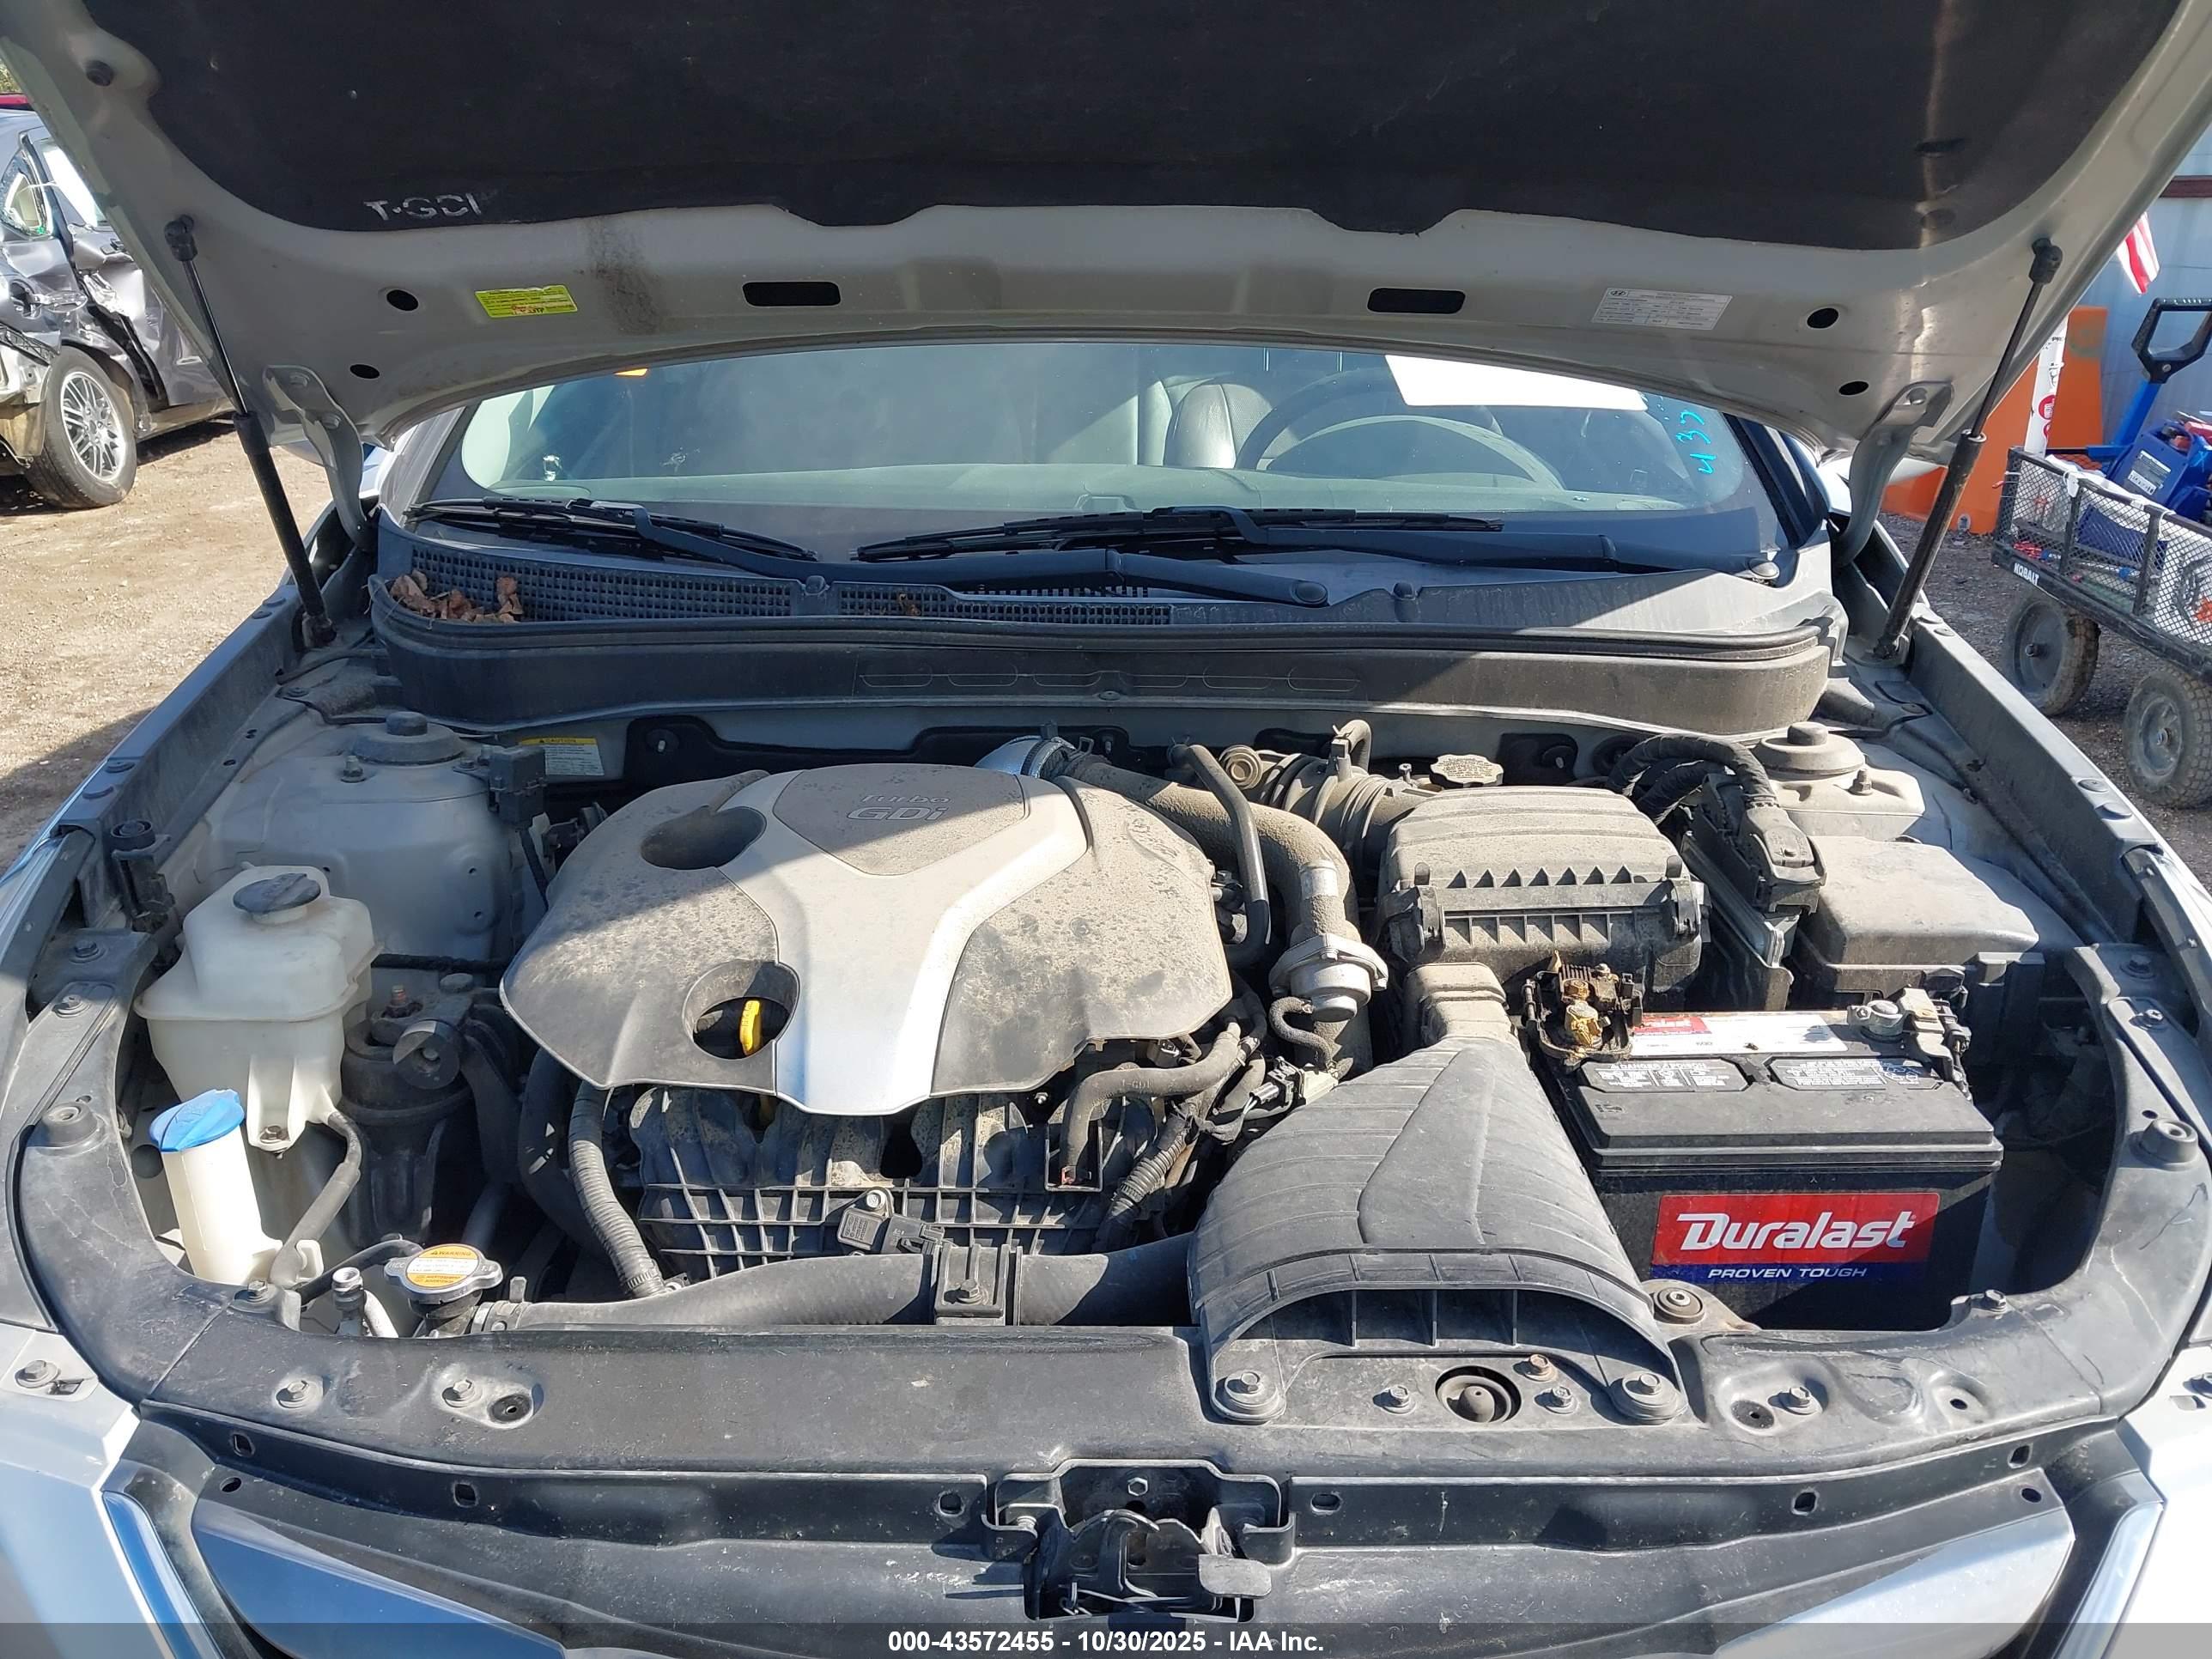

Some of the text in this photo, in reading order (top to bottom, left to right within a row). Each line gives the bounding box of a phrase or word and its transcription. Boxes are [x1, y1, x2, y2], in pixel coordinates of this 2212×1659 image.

[2014, 562, 2039, 586] KOBALT
[847, 806, 948, 821] GDi
[1676, 1211, 1917, 1251] Duralast
[1708, 1267, 1869, 1279] PROVEN TOUGH
